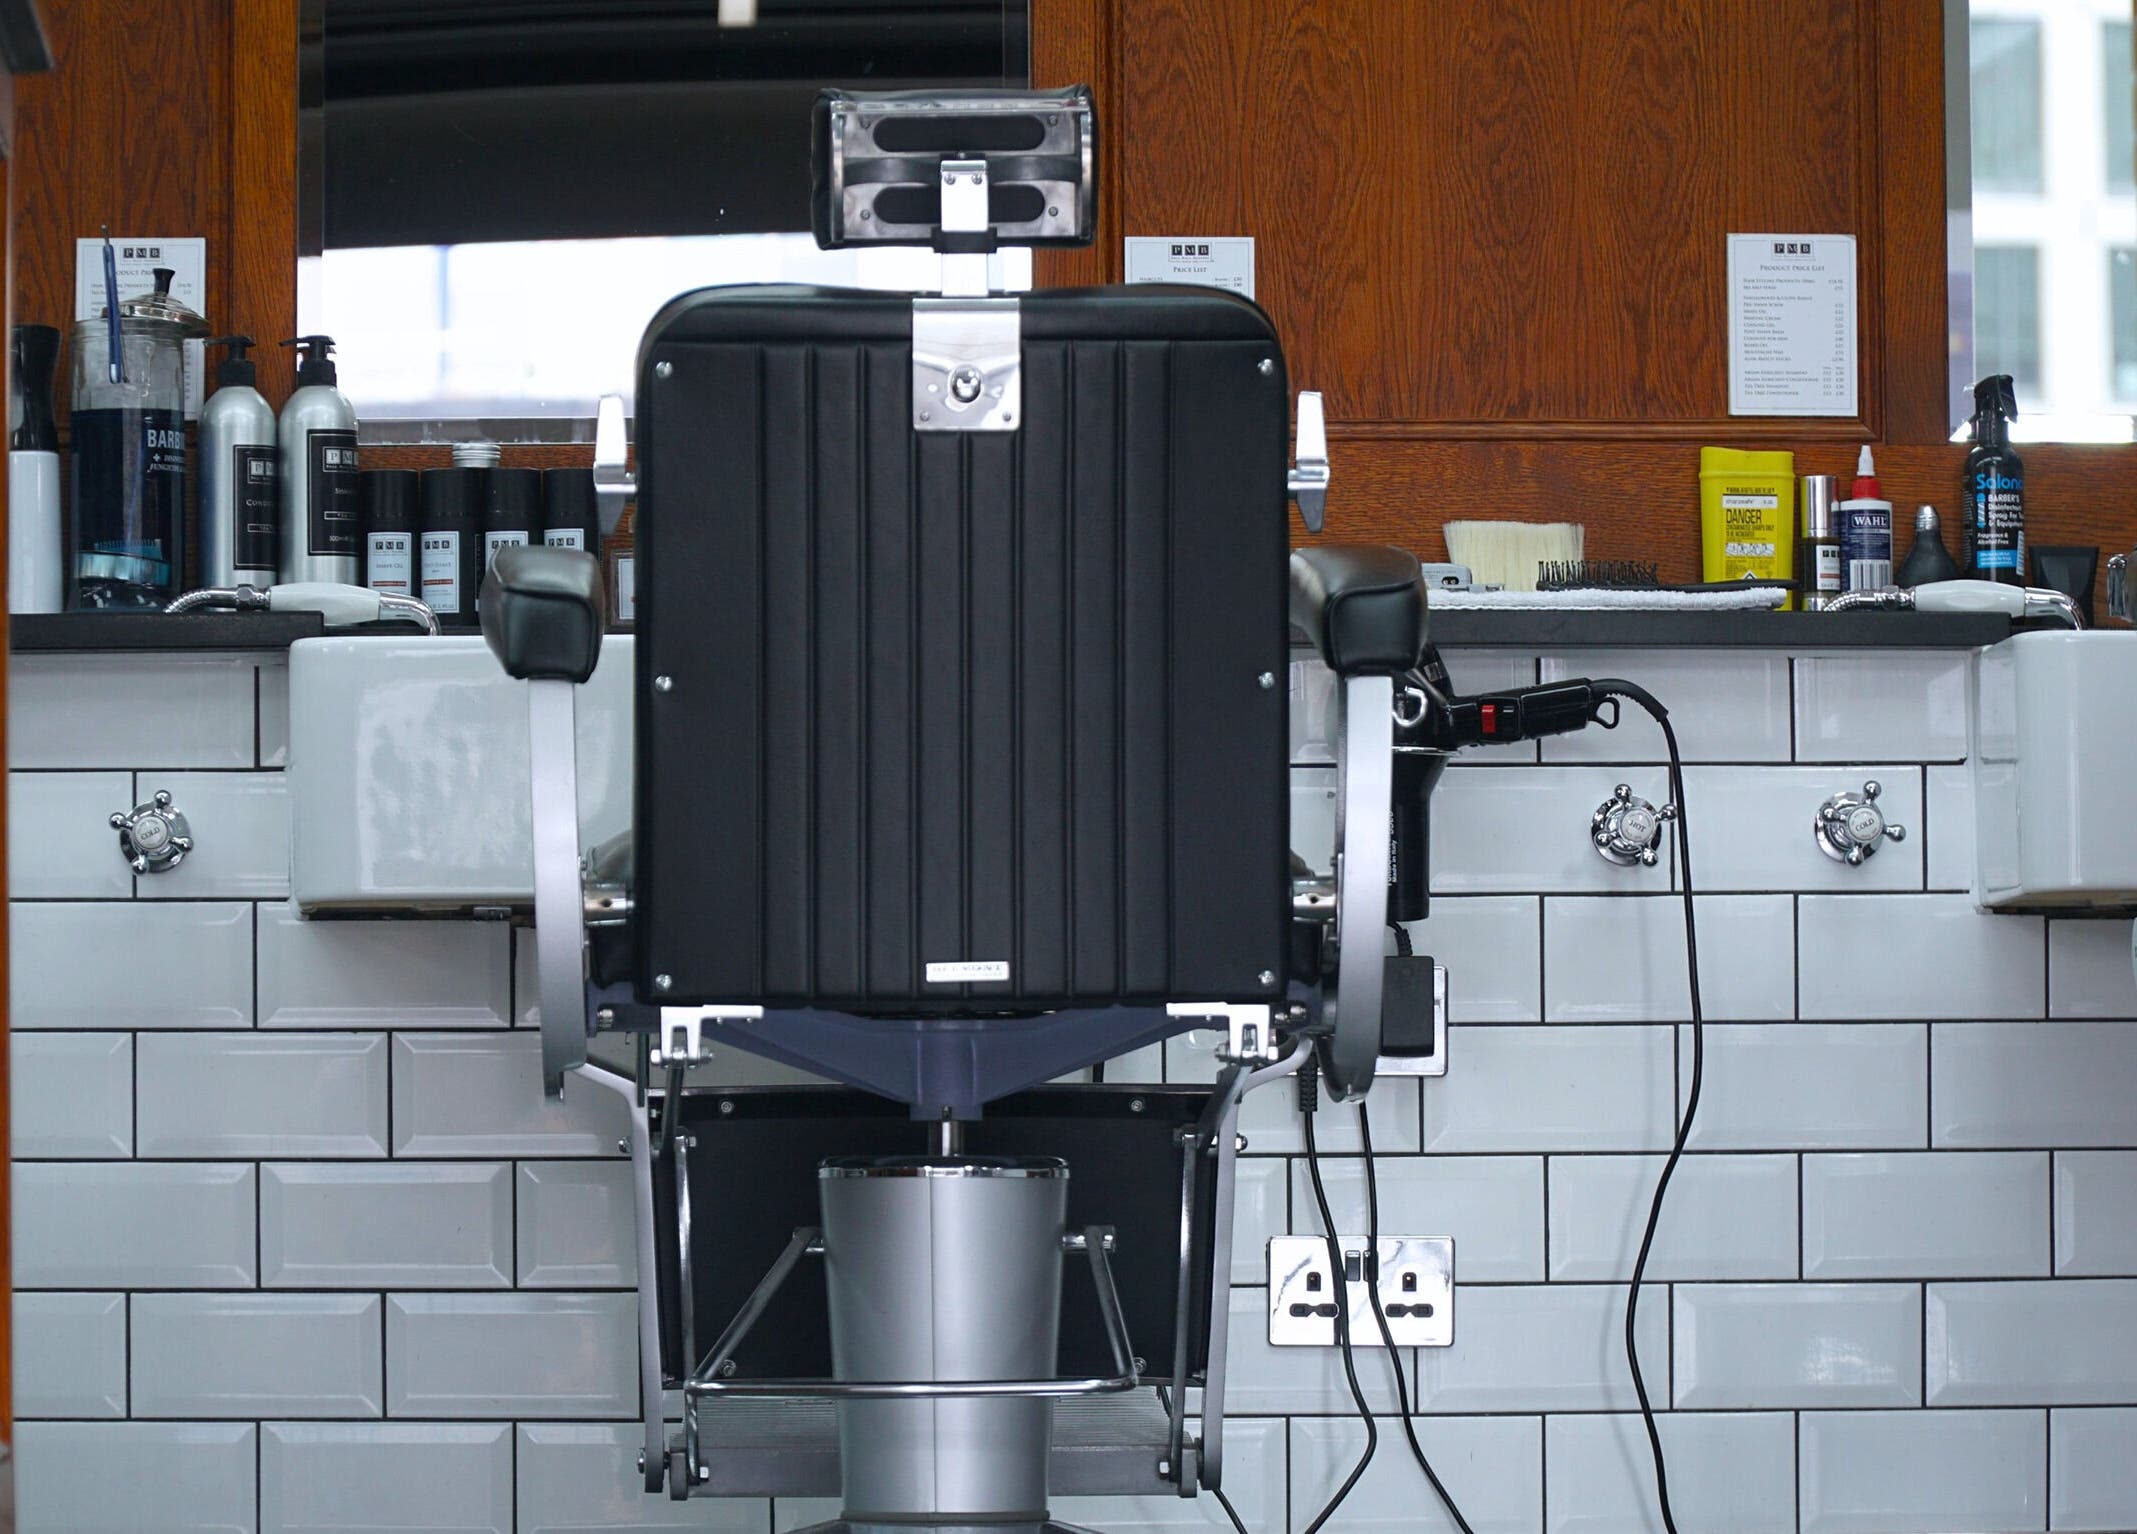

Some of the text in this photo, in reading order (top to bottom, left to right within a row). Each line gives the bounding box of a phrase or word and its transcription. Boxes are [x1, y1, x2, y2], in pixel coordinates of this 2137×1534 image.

[1988, 494, 2020, 503] BARBER'S
[1726, 508, 1762, 524] DANGER
[1854, 516, 1887, 526] WAHL
[1628, 819, 1647, 832] HOT
[1855, 817, 1875, 832] COLD
[140, 826, 160, 840] COLD
